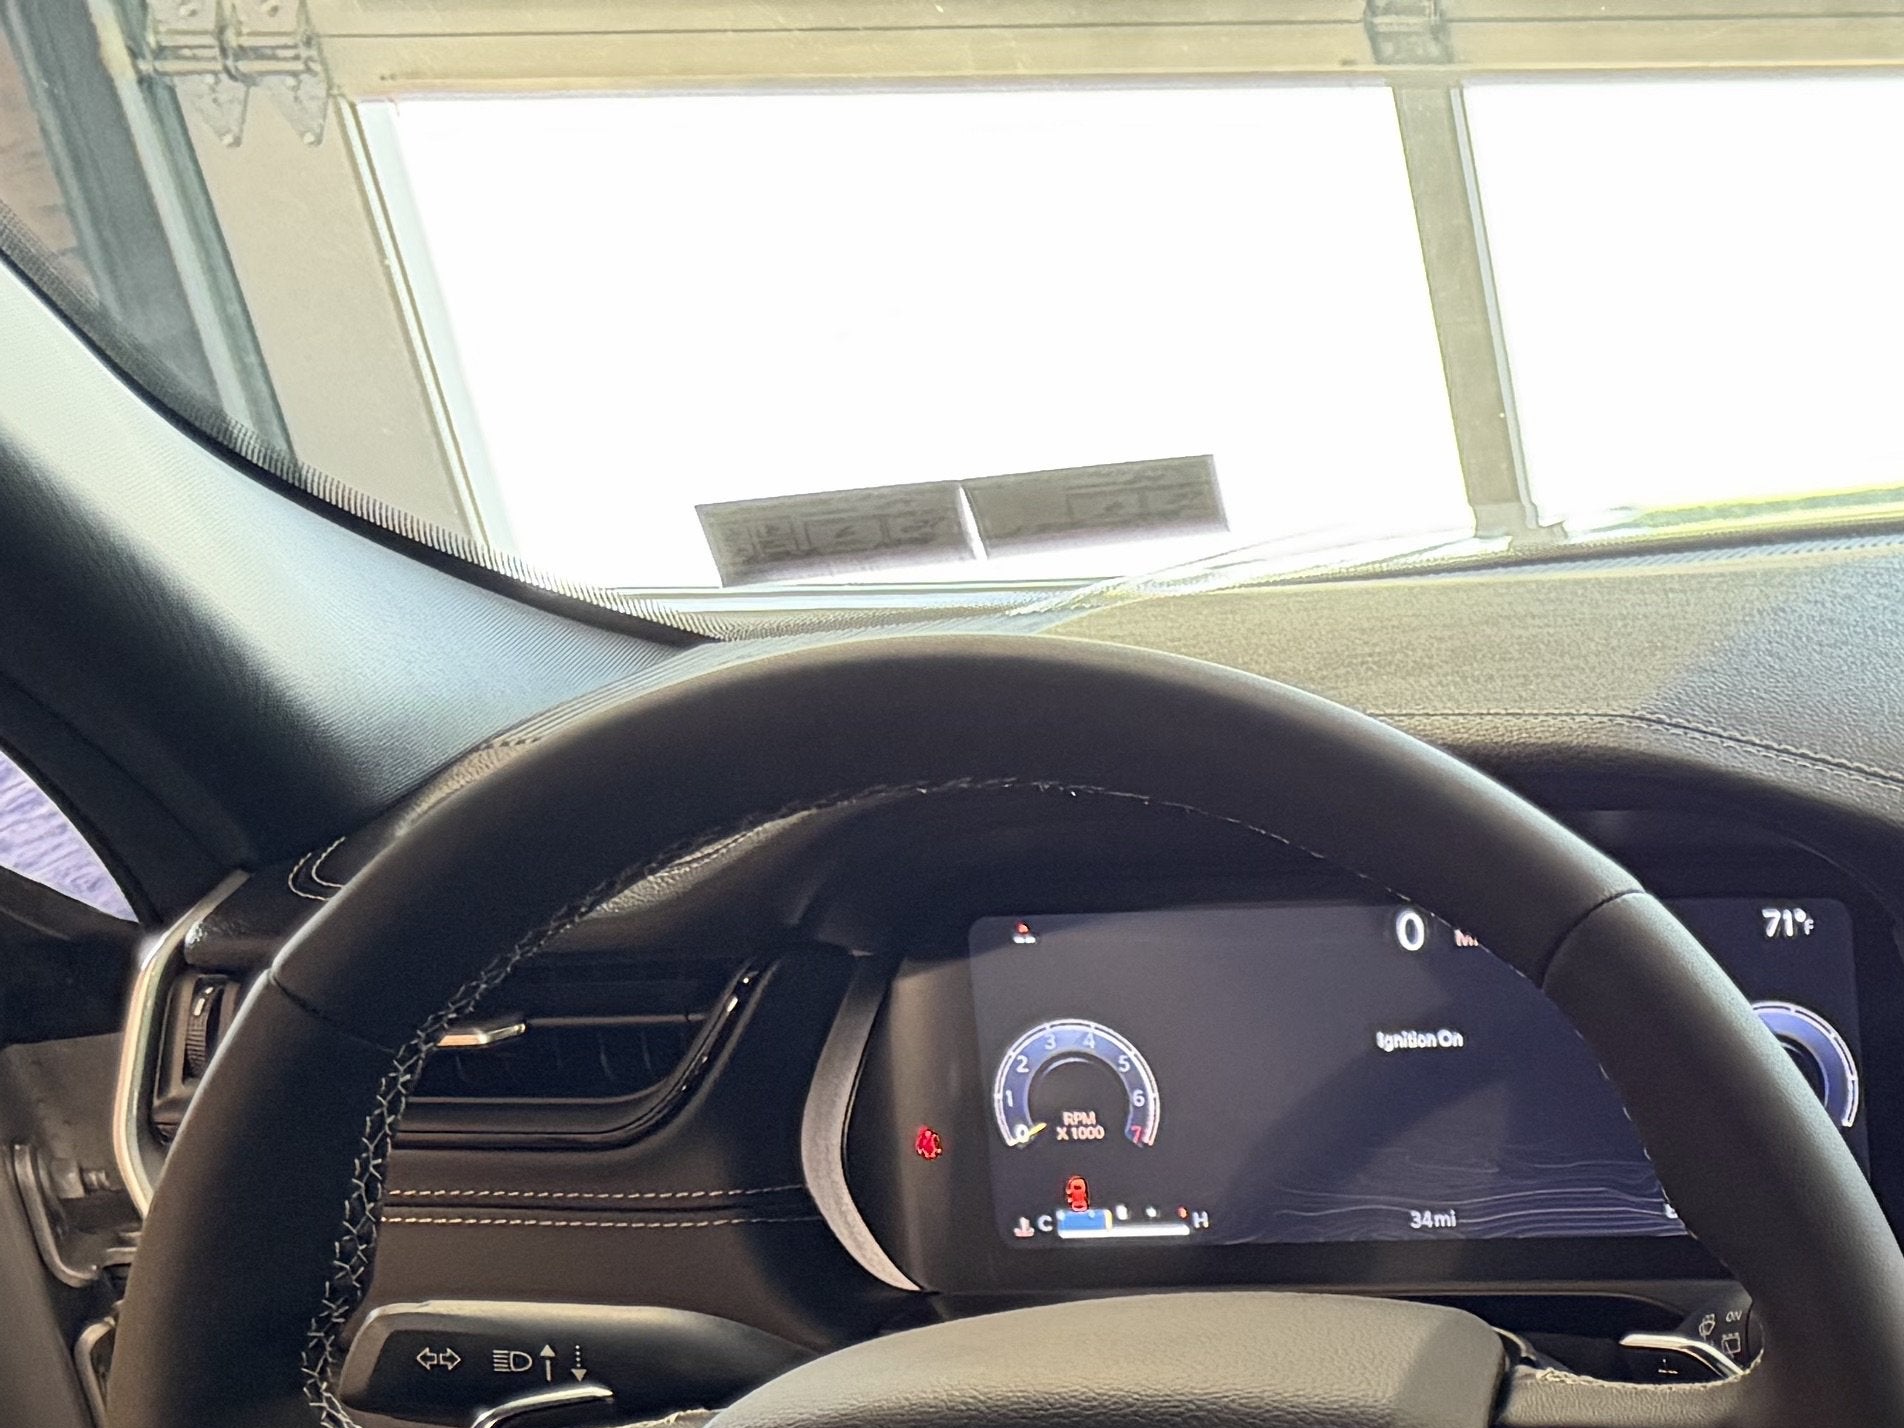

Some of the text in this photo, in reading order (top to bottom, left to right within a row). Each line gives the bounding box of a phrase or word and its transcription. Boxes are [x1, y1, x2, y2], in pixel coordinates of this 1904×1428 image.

[1397, 911, 1425, 951] 0
[1045, 1032, 1057, 1049] 3
[1083, 1031, 1096, 1048] 4
[1377, 1029, 1463, 1051] Ignition On
[1016, 1055, 1030, 1073] 2
[1118, 1055, 1131, 1072] 5
[1005, 1090, 1014, 1107] 1
[1132, 1090, 1146, 1107] 6
[1062, 1111, 1096, 1126] RPM
[1015, 1127, 1030, 1143] 0
[1056, 1126, 1105, 1141] X 1000
[1131, 1127, 1145, 1145] 7
[1038, 1214, 1053, 1232] C
[1192, 1210, 1210, 1229] H
